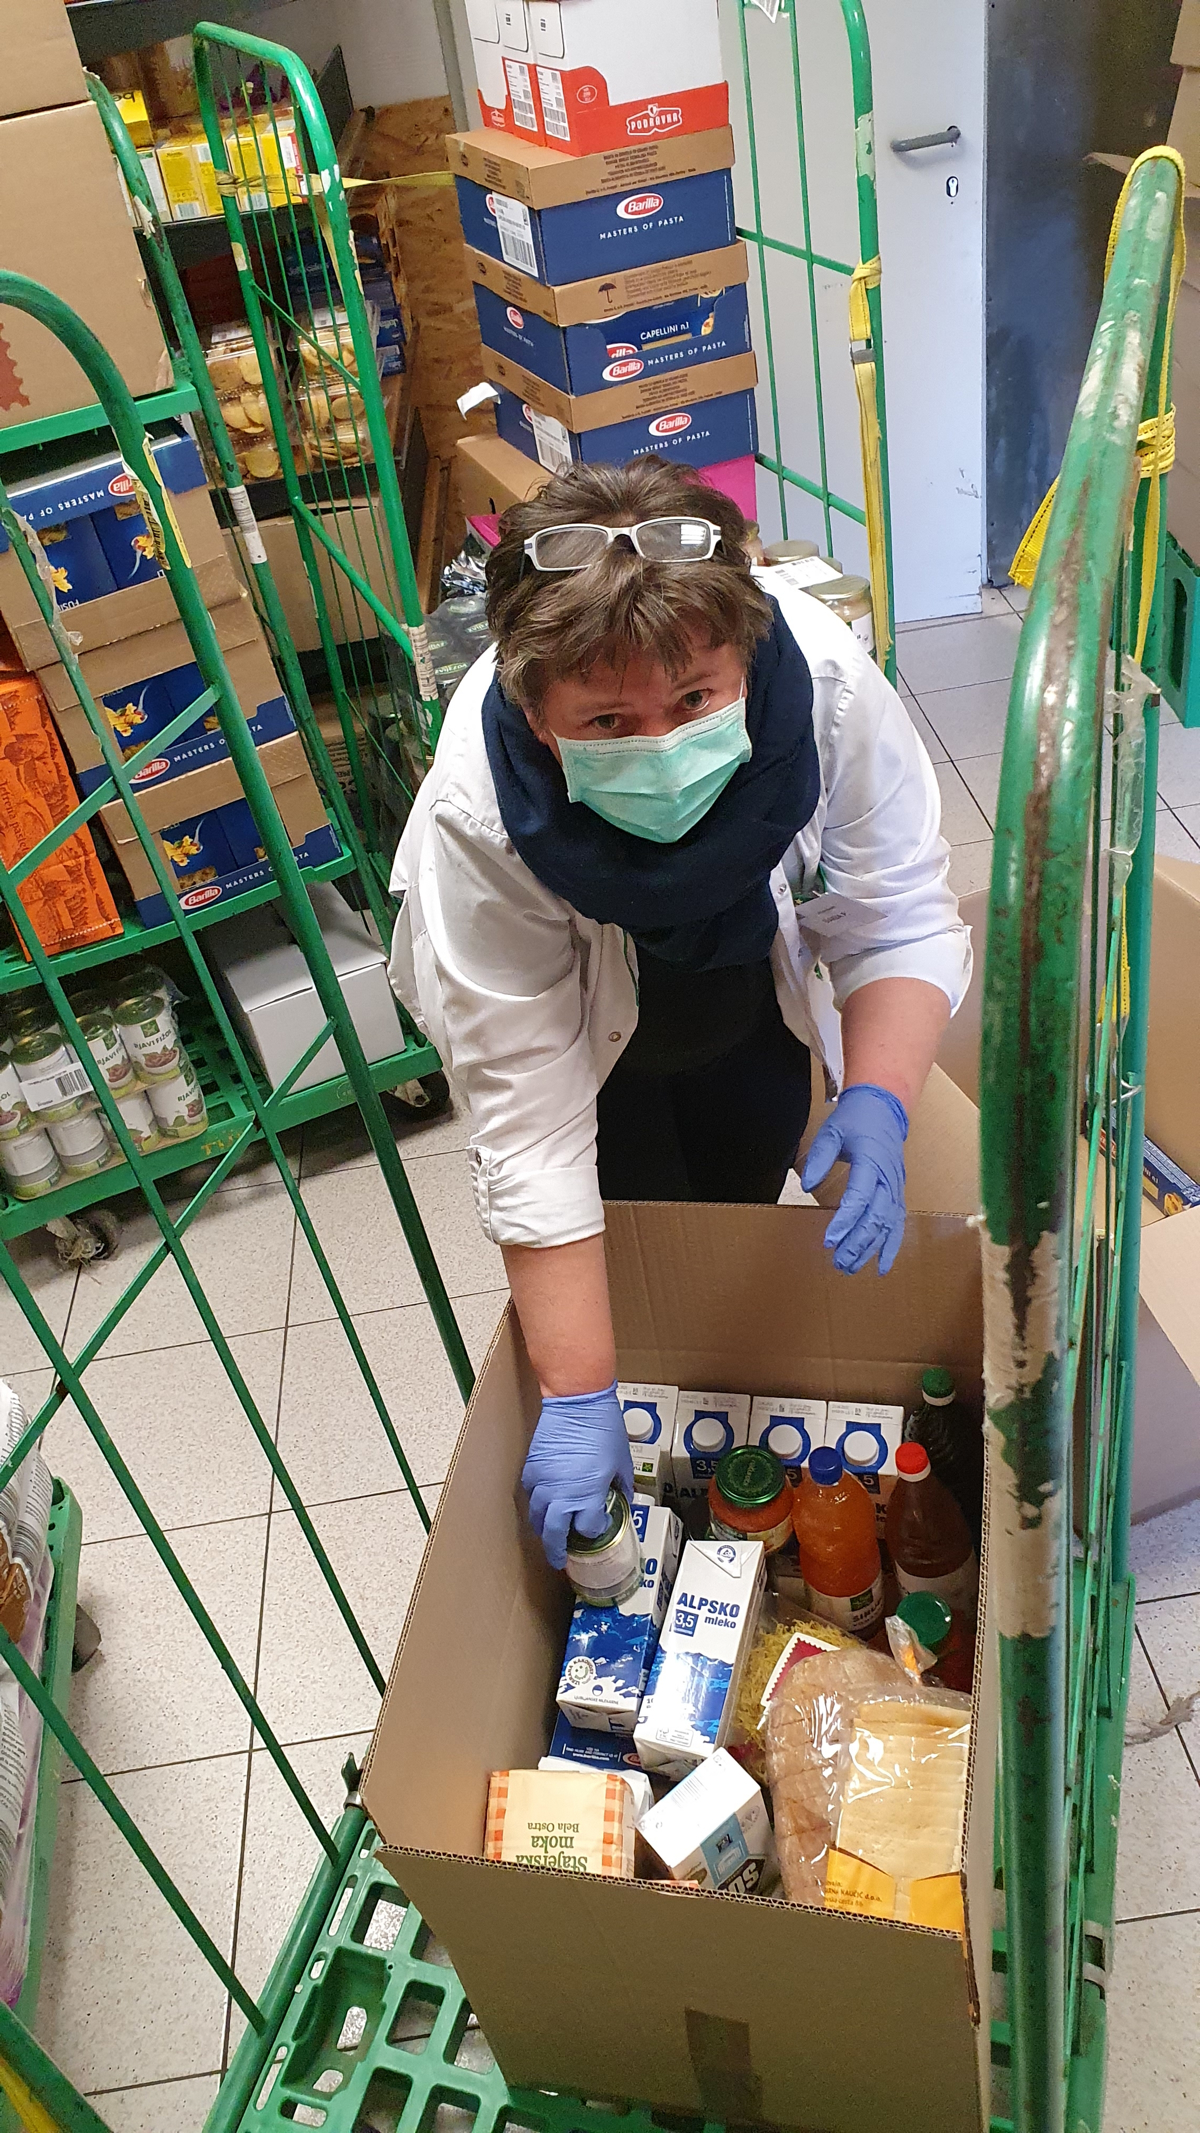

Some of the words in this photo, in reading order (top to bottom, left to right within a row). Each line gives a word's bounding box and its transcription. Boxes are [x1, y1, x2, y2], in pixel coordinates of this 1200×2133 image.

[630, 112, 678, 131] PODRAVKA
[628, 197, 660, 213] Barilla
[599, 225, 638, 240] MASTERS
[642, 222, 653, 231] OF
[658, 215, 685, 228] PASTA
[640, 324, 678, 340] CAPELLINI
[647, 351, 684, 366] MASTERS
[687, 347, 698, 356] OF
[702, 340, 727, 352] PASTA
[612, 360, 641, 377] Barilla
[659, 416, 688, 431] Barilla
[633, 439, 668, 456] MASTERS
[672, 438, 683, 446] OF
[687, 431, 711, 442] PASTA
[57, 489, 105, 512] MASTERS
[39, 507, 53, 518] OF
[174, 742, 215, 763] MASTERS
[225, 869, 265, 889] MASTERS
[188, 888, 218, 905] Barilla
[676, 1592, 740, 1618] ALPSKO
[675, 1612, 696, 1628] 3,5
[704, 1615, 737, 1629] mleko
[528, 1822, 555, 1832] Ostra
[557, 1823, 580, 1833] Bela
[531, 1835, 574, 1854] moka
